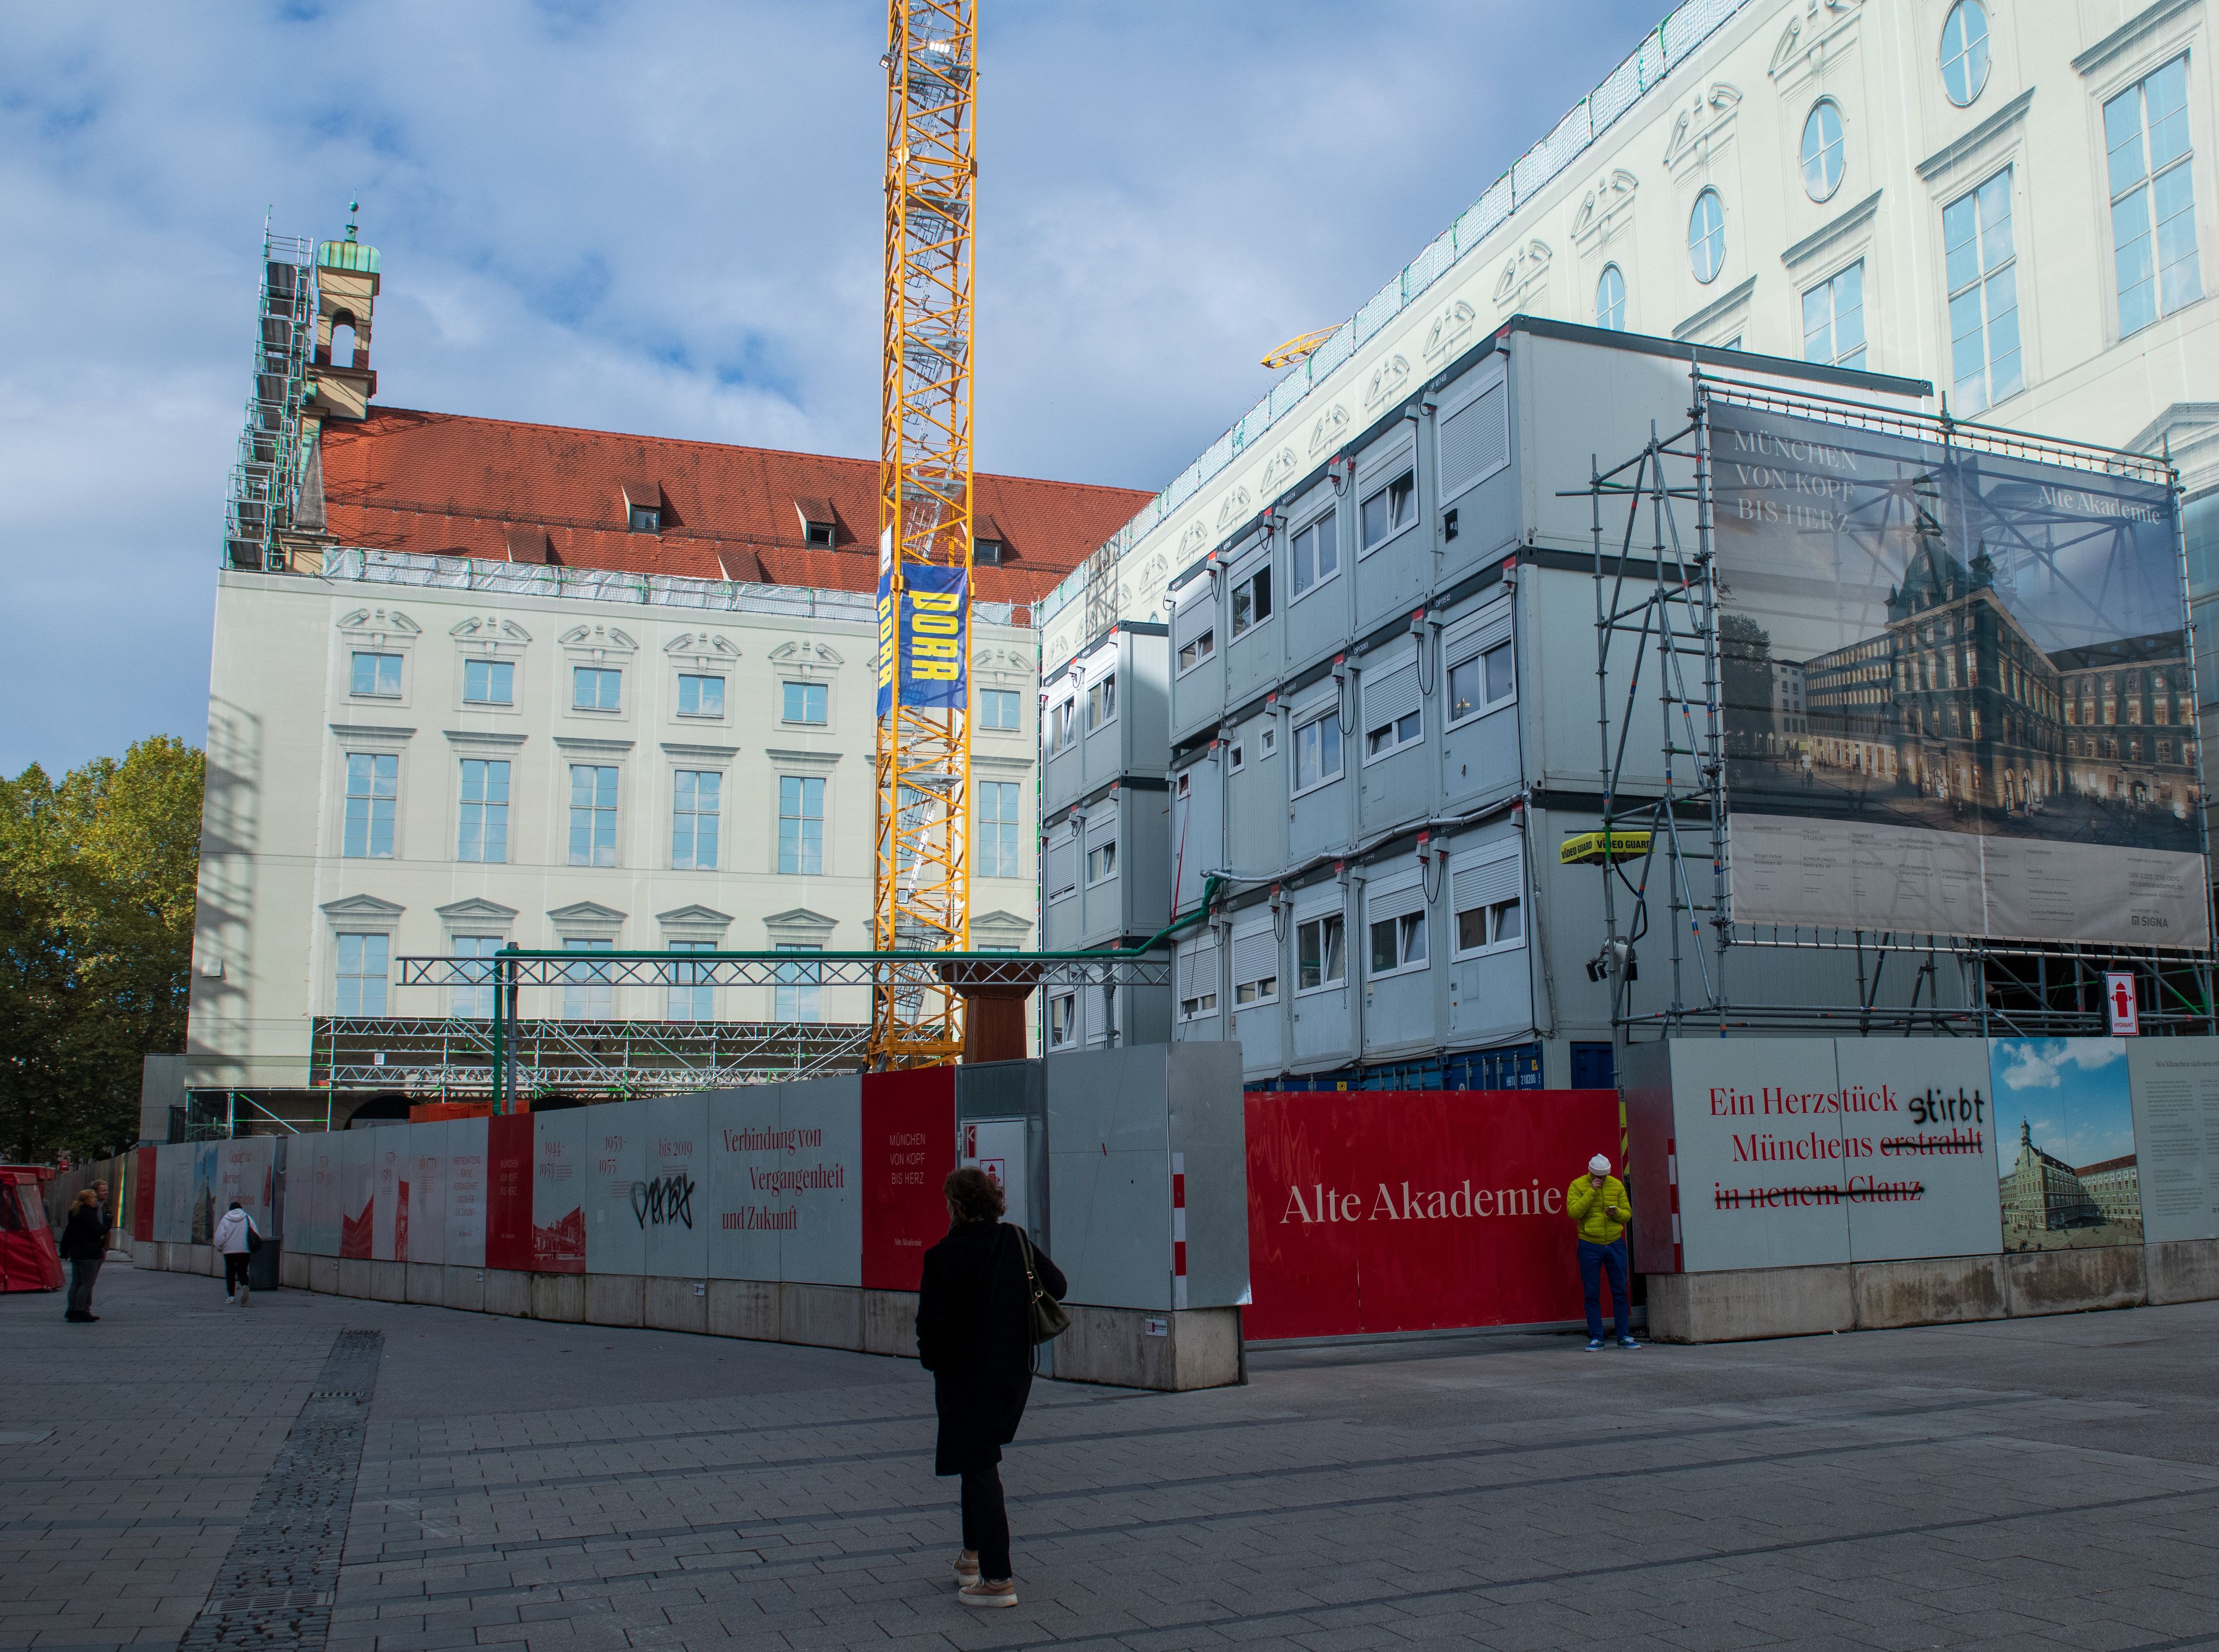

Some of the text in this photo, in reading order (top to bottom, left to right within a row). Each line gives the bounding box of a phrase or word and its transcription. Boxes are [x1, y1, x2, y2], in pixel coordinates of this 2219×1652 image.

[1734, 429, 1856, 470] MÜNCHEN
[1735, 464, 1855, 502] VON KOPF
[1737, 498, 1851, 534] BIS HERZ
[2039, 485, 2161, 525] Alte Akademie
[878, 594, 893, 689] PORR
[908, 590, 959, 681] PORR
[1577, 840, 1592, 853] GUARD
[2141, 916, 2169, 928] SIGNA
[1521, 1074, 1536, 1085] 210200
[1709, 1084, 1899, 1116] Ein Herzstück
[1908, 1088, 1985, 1125] stirbt
[658, 1138, 693, 1159] bis 2019
[723, 1126, 822, 1156] Verbindung von
[889, 1132, 926, 1146] MÜNCHEN
[1731, 1127, 1985, 1162] Münchens erstrahlt
[889, 1152, 926, 1165] VON KOPF
[749, 1163, 845, 1197] Vergangenheit
[891, 1172, 925, 1184] BIS HERZ
[1714, 1175, 1923, 1210] in neuem Glanz
[1279, 1178, 1562, 1223] Alte Akademie
[722, 1205, 798, 1230] und Zukunft
[894, 1238, 923, 1246] Alte Akademie
